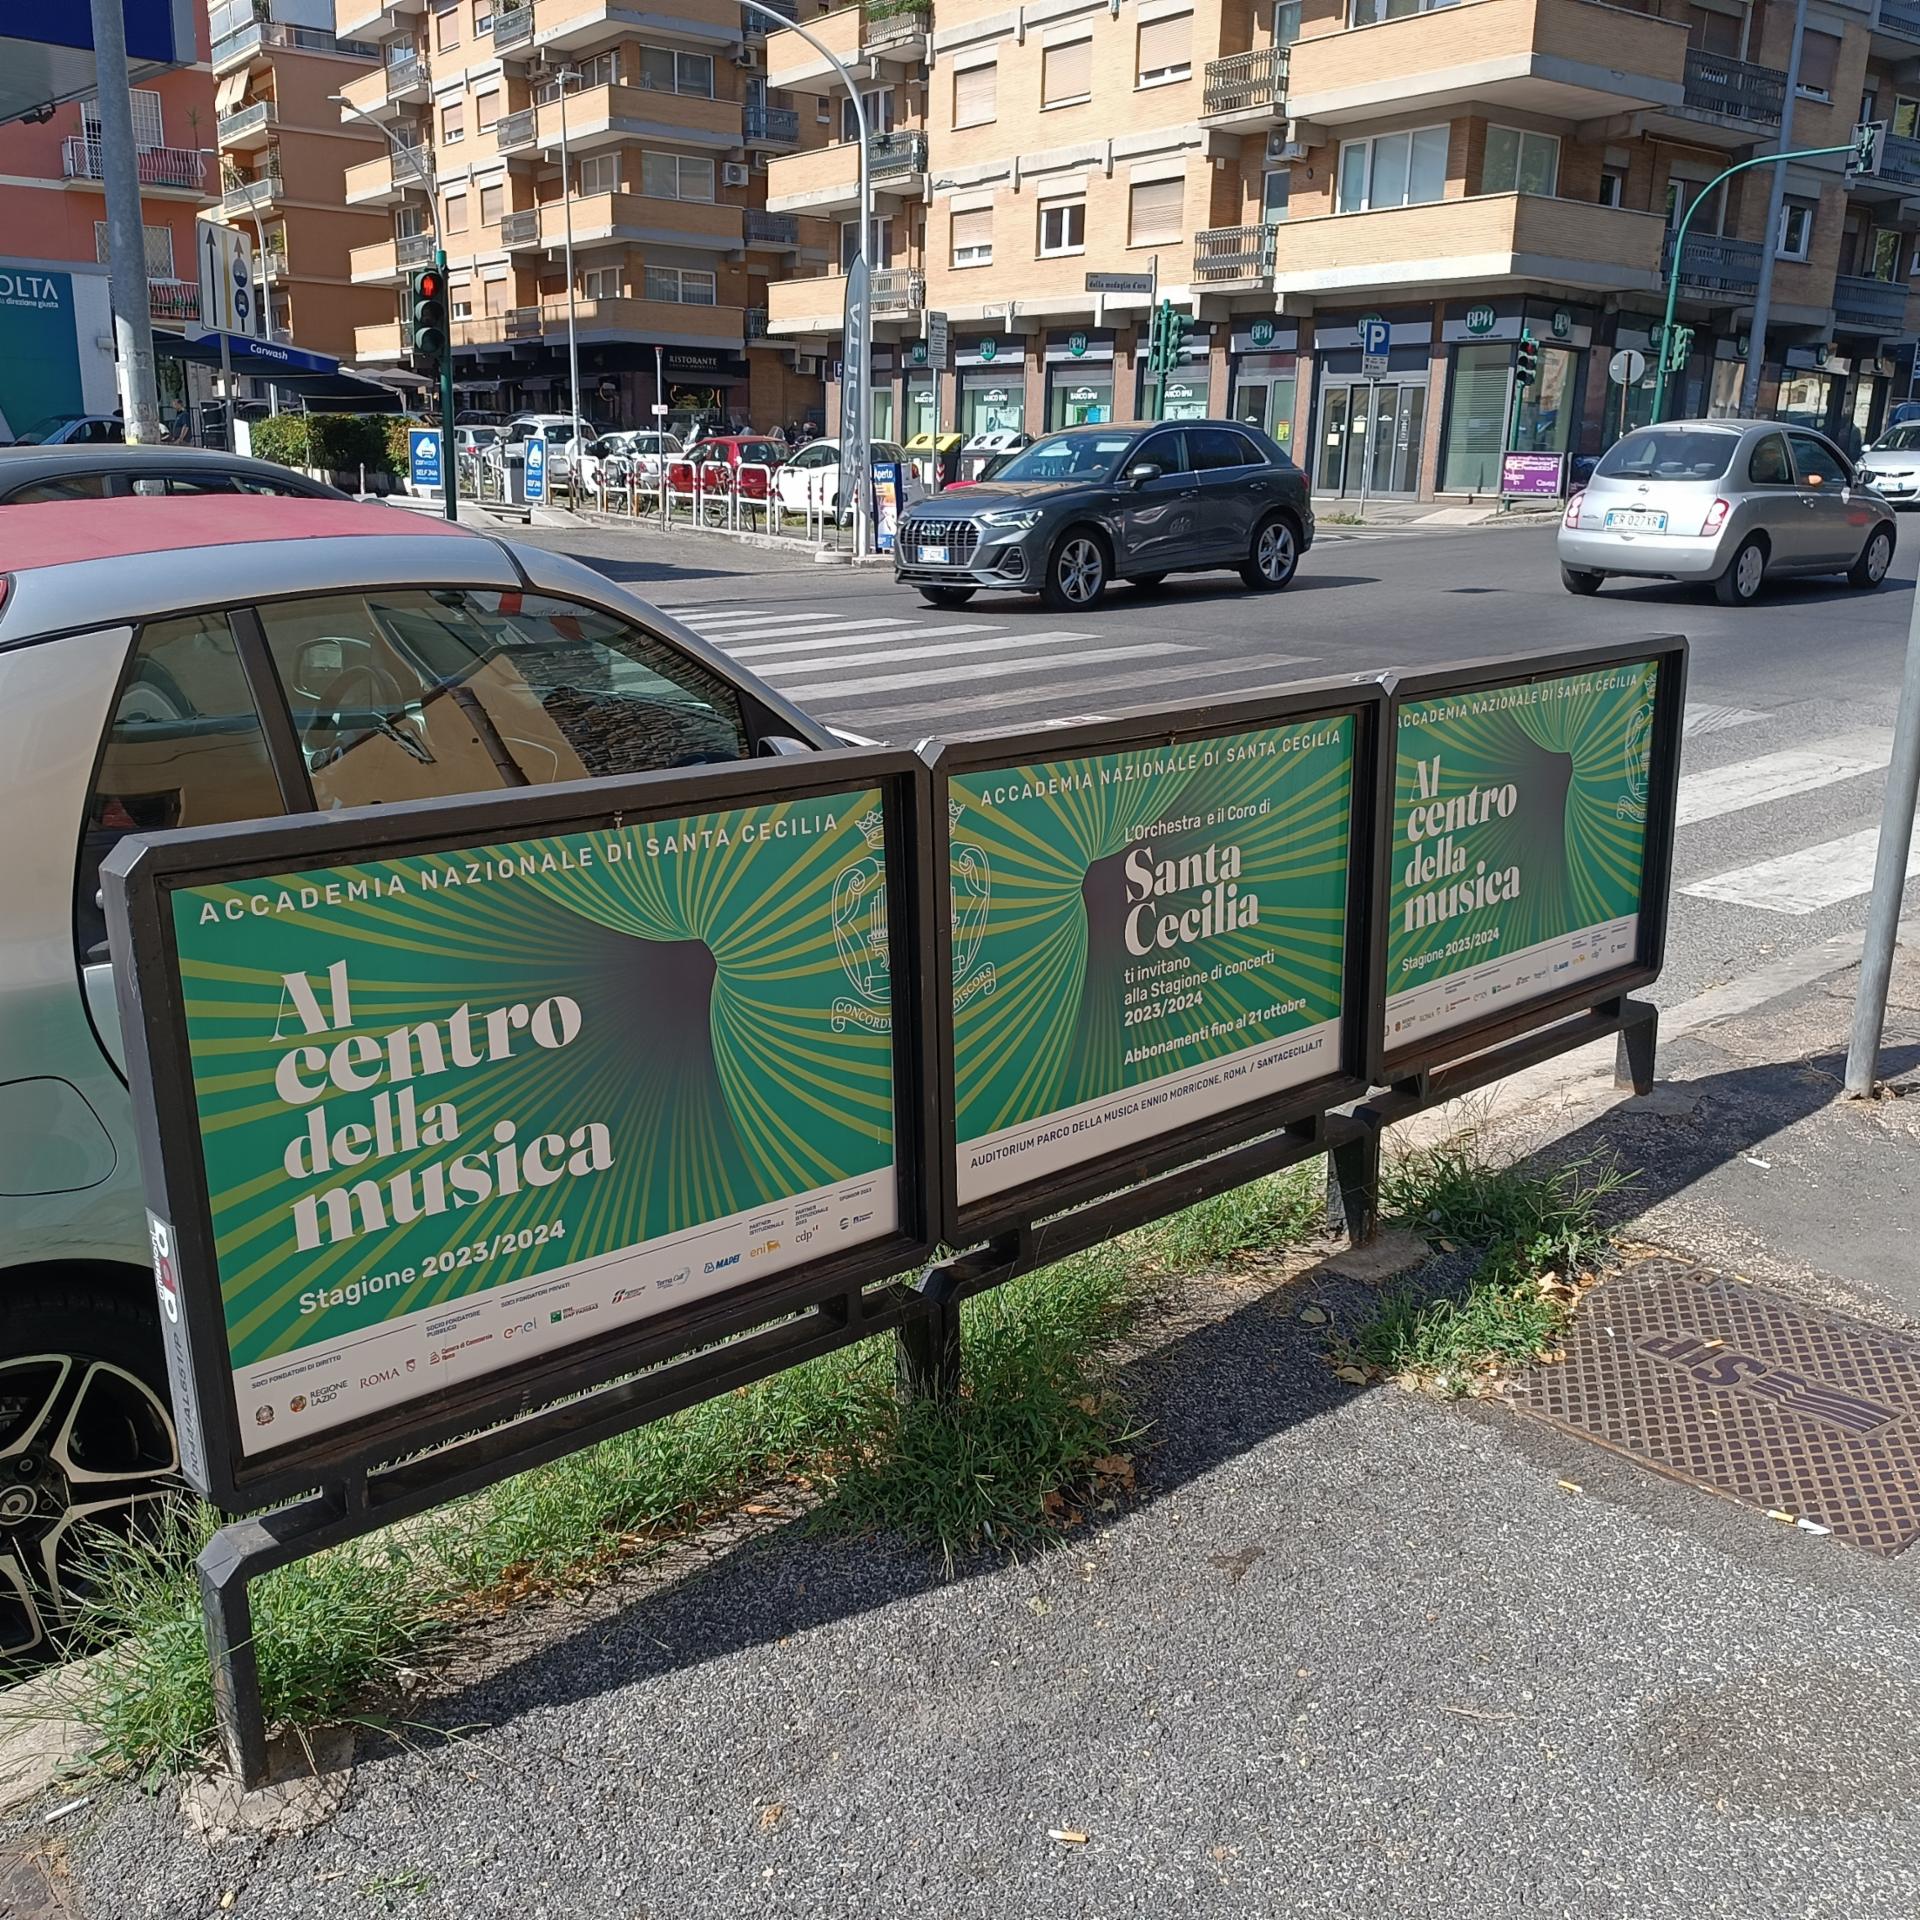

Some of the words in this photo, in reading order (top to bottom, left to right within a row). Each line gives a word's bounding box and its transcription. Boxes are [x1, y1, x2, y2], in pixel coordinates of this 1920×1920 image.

[1251, 324, 1273, 340] BPM
[1370, 325, 1386, 352] P
[1466, 310, 1494, 328] BPM
[250, 343, 288, 360] Carwash
[669, 355, 718, 366] RISTORANTE
[1165, 389, 1180, 398] ANCO
[873, 469, 893, 481] Aperto
[1471, 690, 1537, 715] NAZIONALE
[1541, 688, 1553, 702] DI
[1556, 684, 1591, 700] SANTA
[1595, 674, 1637, 692] CECILIA
[980, 774, 1094, 807] ACCADEMIA
[1100, 755, 1196, 785] NAZIONALE
[1204, 749, 1219, 767] DI
[1226, 740, 1277, 763] SANTA
[1282, 729, 1341, 753] CECILIA
[1408, 754, 1440, 803] Al
[1125, 814, 1201, 843] L'Orchestra
[1207, 812, 1214, 826] e
[1217, 808, 1225, 824] il
[1227, 803, 1257, 821] Coro
[1259, 798, 1271, 814] di
[1407, 784, 1518, 842] centro
[199, 875, 406, 925] ACCADEMIA
[421, 847, 593, 890] NAZIONALE
[607, 844, 633, 863] DI
[646, 828, 731, 857] SANTA
[742, 813, 838, 843] CECILIA
[1125, 843, 1242, 904] Santa
[1404, 835, 1466, 888] della
[1403, 860, 1521, 934] musica
[1124, 883, 1260, 956] Cecilia
[1124, 967, 1134, 984] ti
[1137, 955, 1191, 980] invitano
[1402, 947, 1444, 972] Stagione
[1445, 927, 1500, 956] 2023/2024
[1124, 987, 1148, 1006] alla
[1150, 972, 1209, 998] Stagione
[1210, 963, 1223, 980] di
[1225, 949, 1275, 976] concerti
[268, 959, 355, 1042] Al
[1124, 991, 1203, 1027] 2023/2024
[275, 996, 582, 1105] centro
[1123, 1024, 1209, 1066] Abbonamenti
[1210, 1020, 1234, 1036] fino
[1235, 1013, 1247, 1029] al
[1248, 1008, 1262, 1025] 21
[1263, 997, 1307, 1019] ottobre
[970, 1137, 1035, 1168] AUDITORIUM
[1037, 1125, 1070, 1146] PARCO
[1072, 1115, 1102, 1133] DELLA
[1103, 1102, 1139, 1123] MUSICA
[1141, 1092, 1168, 1110] ENNIO
[1223, 1065, 1247, 1081] ROMA
[1257, 1038, 1323, 1069] SANTACECILIA.IT
[283, 1085, 461, 1179] della
[289, 1120, 616, 1253] musica
[750, 1243, 766, 1257] eni
[795, 1229, 813, 1243] cdp
[299, 1266, 416, 1315] Stagione
[421, 1219, 566, 1278] 2023/2024
[715, 1254, 742, 1270] MAPEI
[445, 1310, 481, 1326] FONDATORE
[504, 1316, 537, 1339] enel
[251, 1378, 268, 1389] SOCI
[268, 1365, 307, 1383] FONDATORI
[307, 1362, 315, 1370] DI
[315, 1354, 342, 1368] DIRITTO
[310, 1379, 348, 1398] REGIONE
[359, 1368, 400, 1389] ROMA
[310, 1392, 338, 1407] LAZIO
